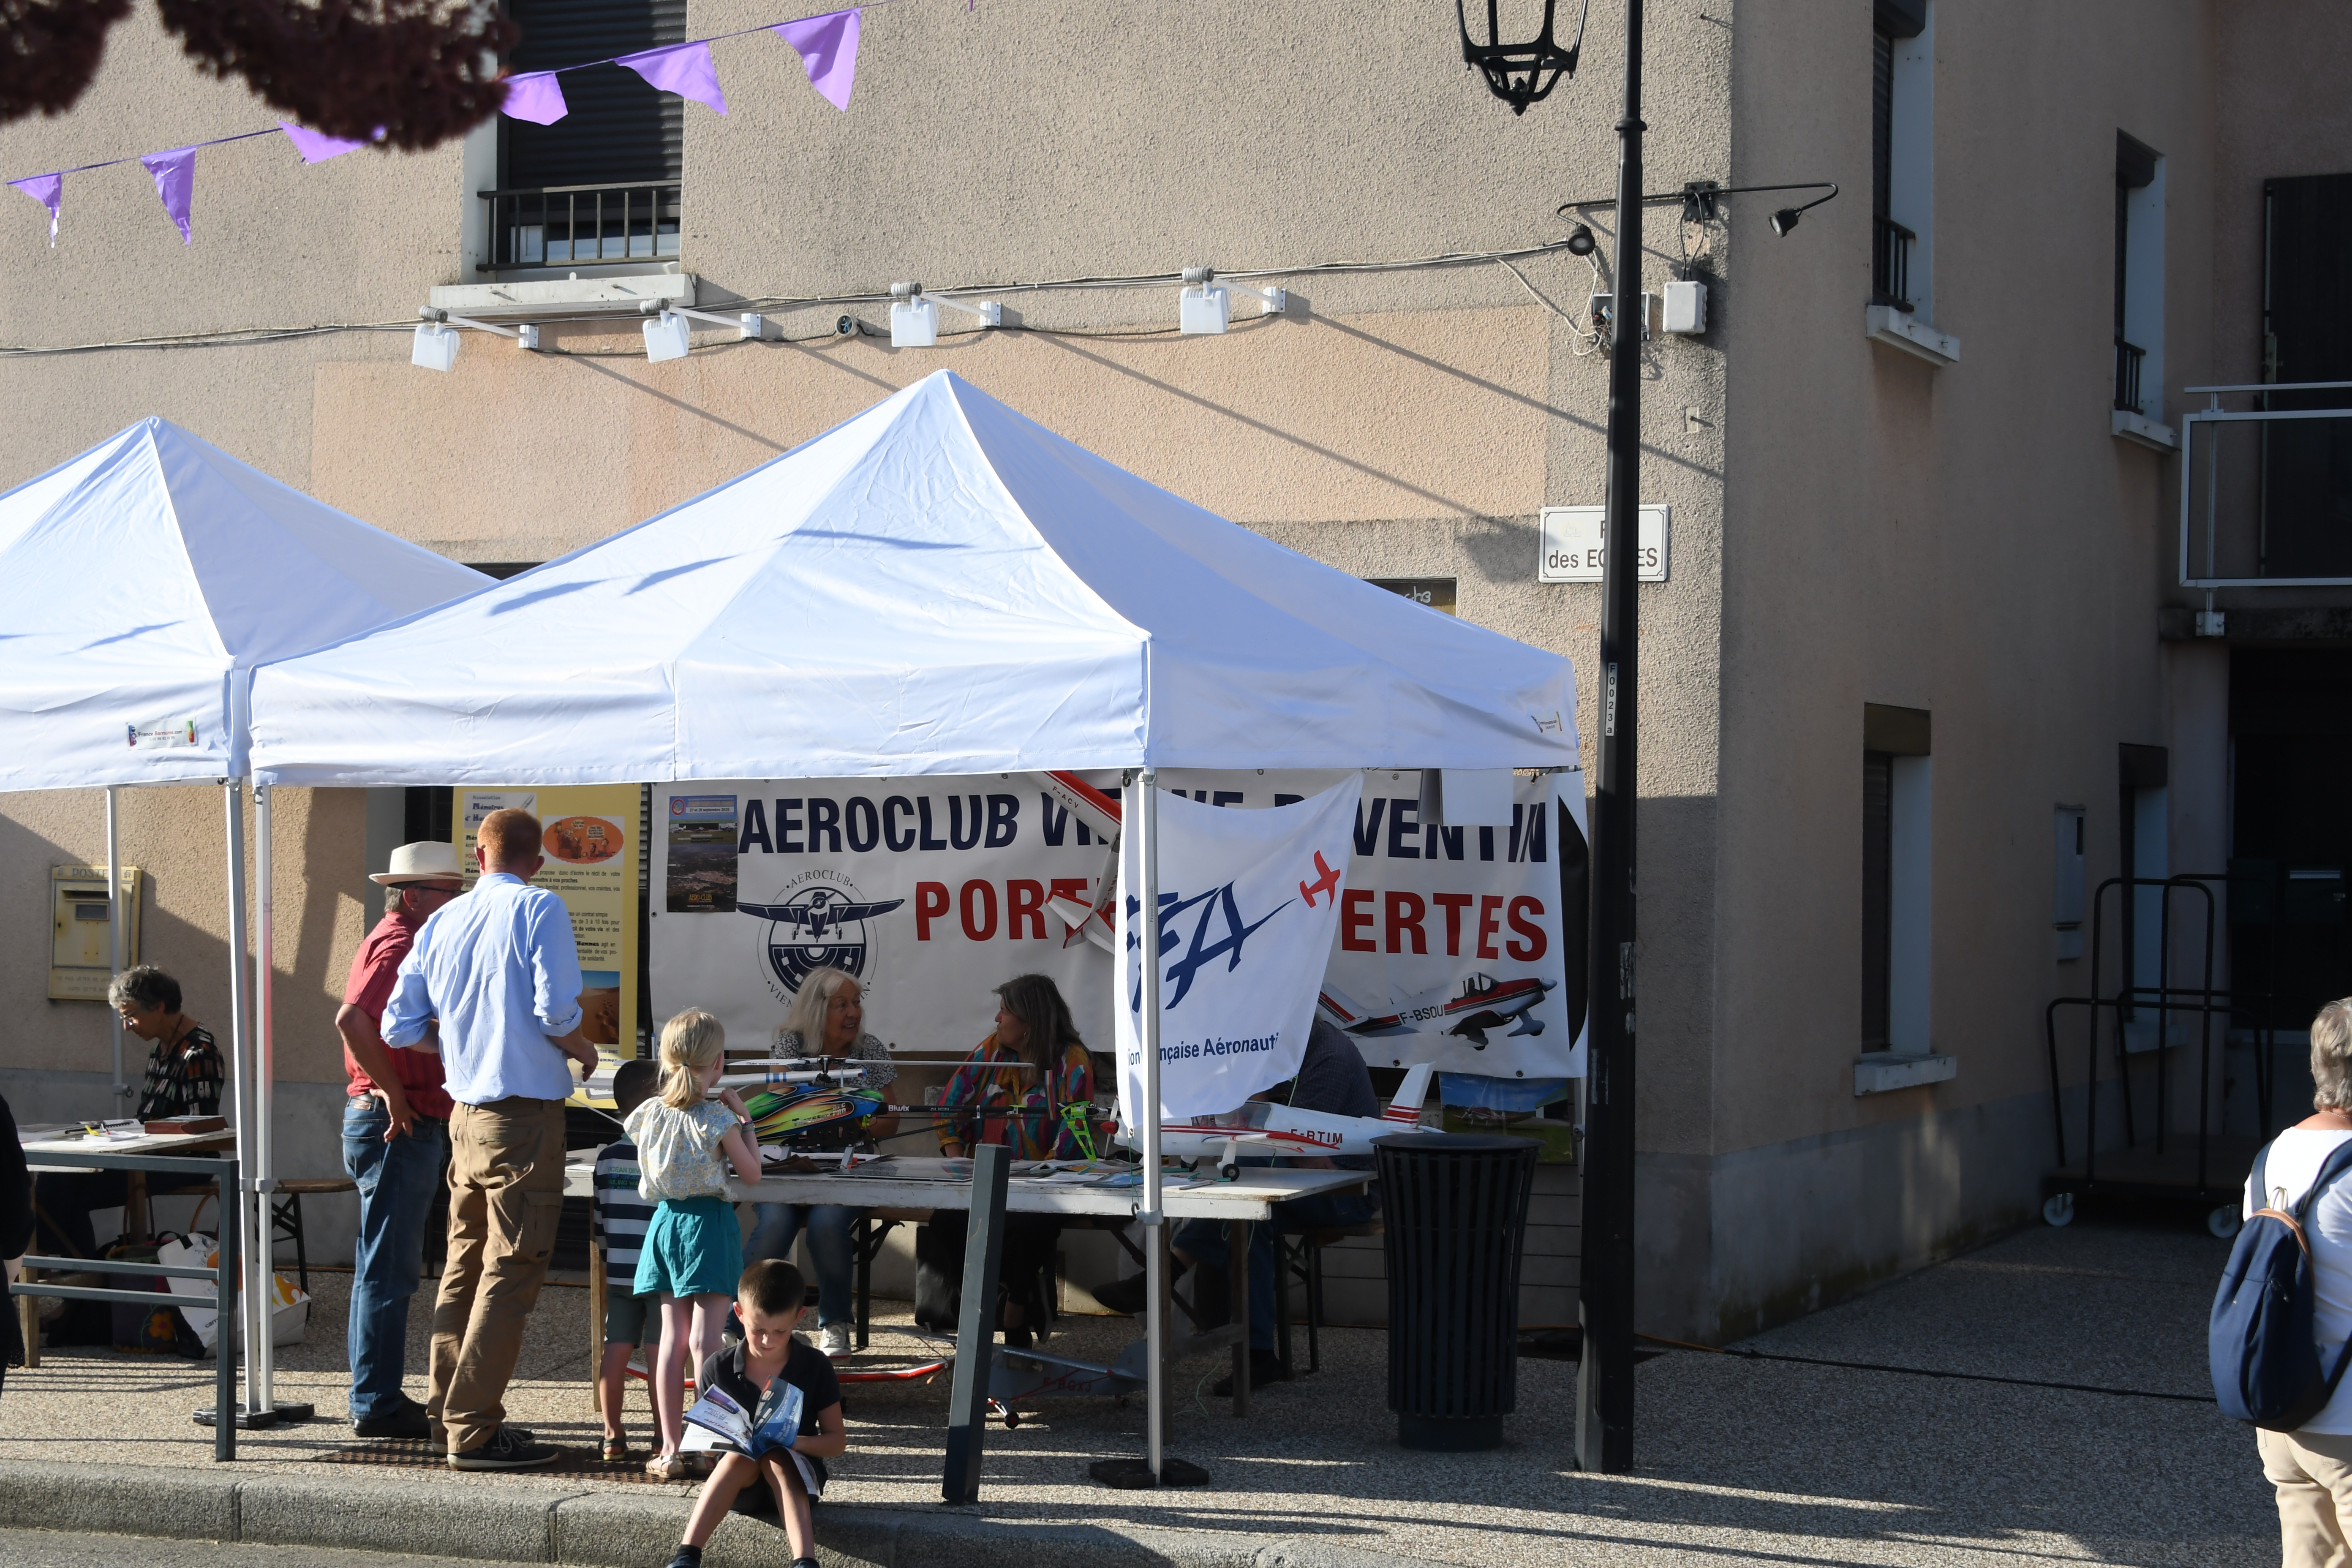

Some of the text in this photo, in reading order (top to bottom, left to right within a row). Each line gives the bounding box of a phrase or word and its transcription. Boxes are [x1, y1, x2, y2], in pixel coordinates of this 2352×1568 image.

[1549, 550, 1579, 569] des
[1607, 665, 1616, 734] F0023a
[738, 794, 1020, 854] AEROCLUB
[791, 869, 850, 888] AEROCLUB
[1342, 889, 1547, 962] ERTES
[769, 984, 792, 1008] VIEN
[1399, 1004, 1443, 1024] F-BSOU
[1160, 1040, 1199, 1064] nçaise
[1203, 1032, 1279, 1056] Aéronauti
[833, 1108, 846, 1116] PRO
[704, 1418, 734, 1434] RICHELIEU
